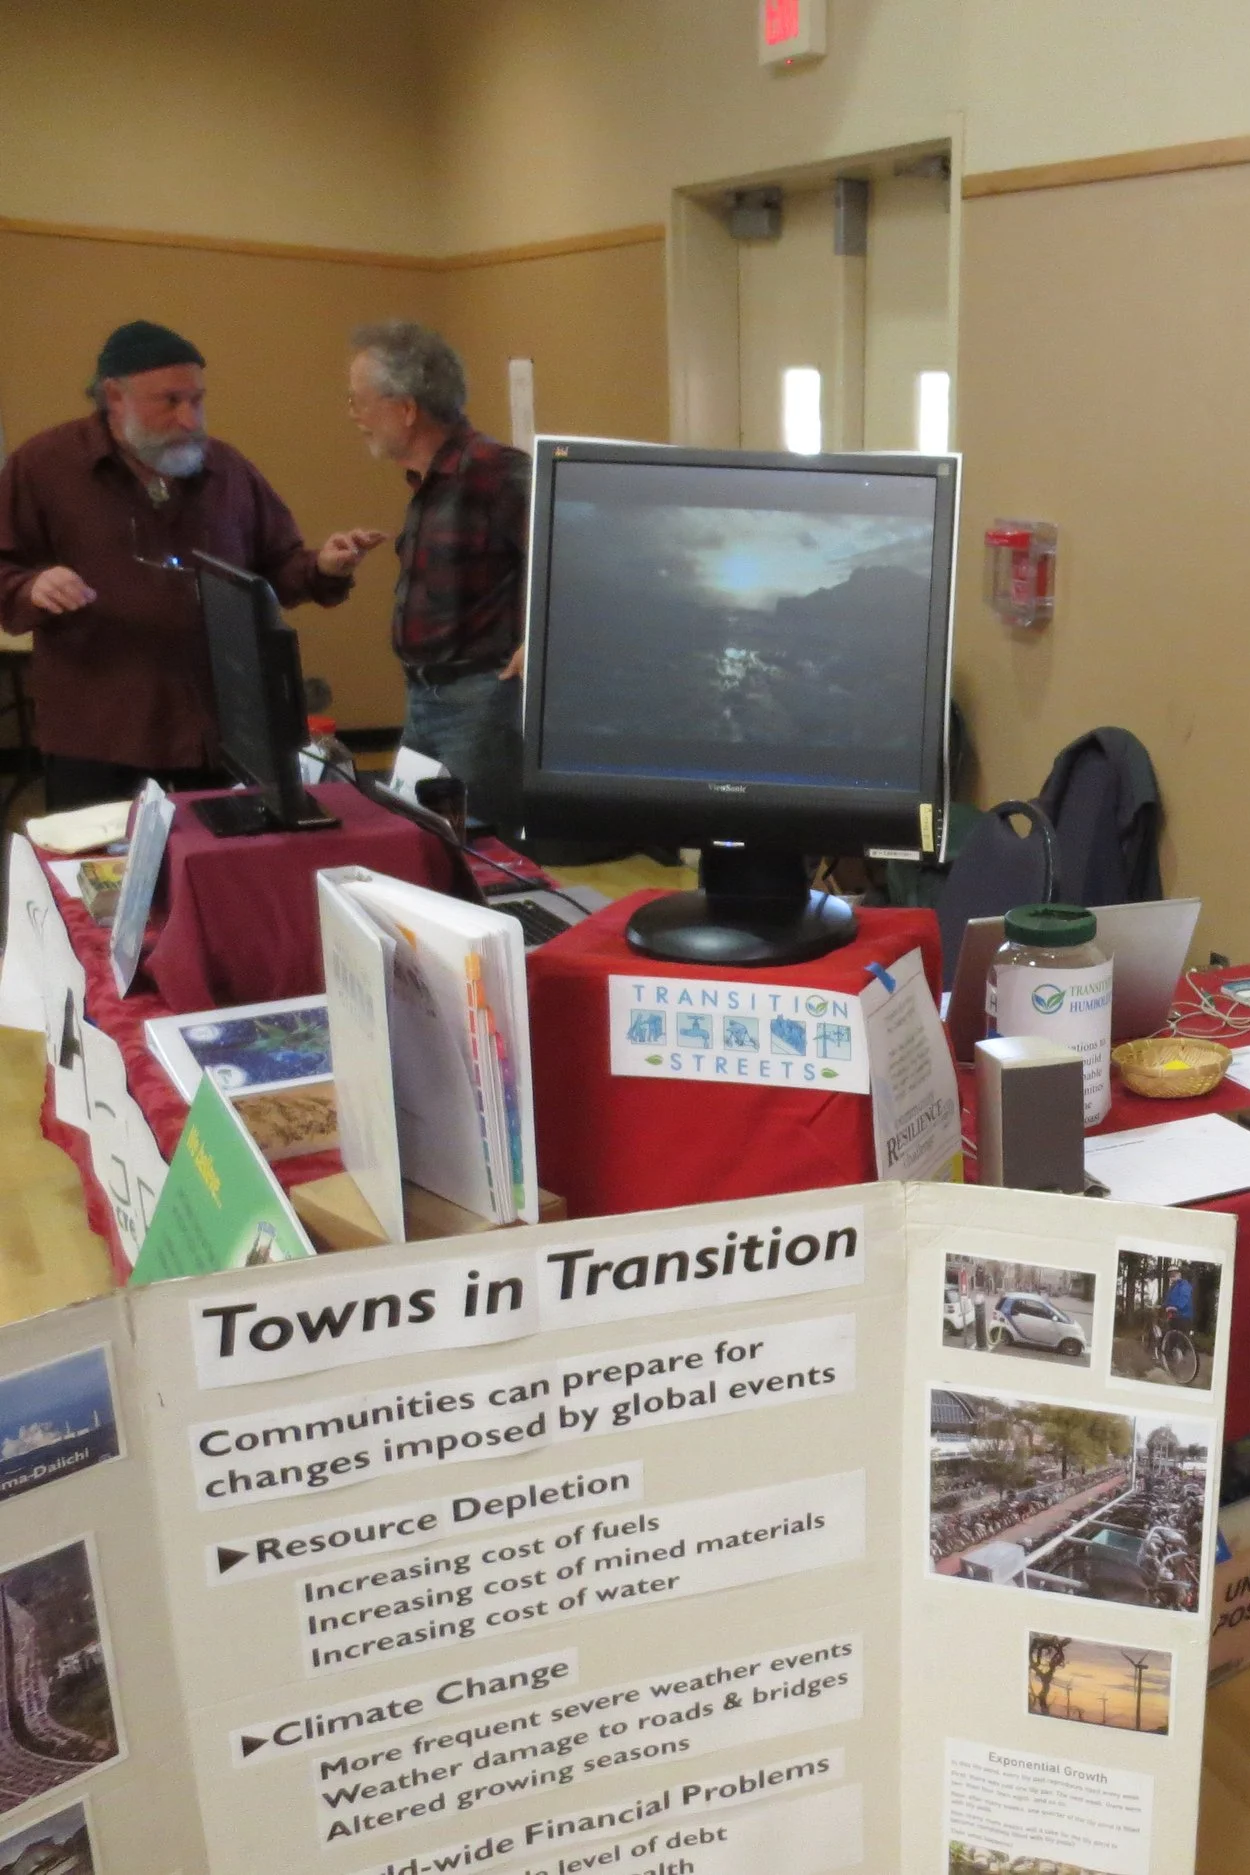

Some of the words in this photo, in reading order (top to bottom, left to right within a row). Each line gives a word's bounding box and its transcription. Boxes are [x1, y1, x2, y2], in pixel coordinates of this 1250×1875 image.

[632, 984, 848, 1019] TRANSITION
[670, 1053, 816, 1081] STREETS
[202, 1288, 436, 1358] Towns
[464, 1269, 524, 1318] in
[546, 1225, 858, 1301] Transition
[199, 1390, 476, 1457] Communities
[488, 1378, 550, 1405] can
[562, 1351, 704, 1397] prepare
[714, 1341, 764, 1365] for
[205, 1450, 371, 1498] changes
[384, 1412, 547, 1462] imposed
[559, 1405, 599, 1432] by
[612, 1381, 717, 1426] global
[728, 1366, 836, 1399] events
[1, 1447, 90, 1491] ma-Daiichi
[255, 1513, 438, 1564] Resource
[452, 1473, 630, 1523] Depletion
[304, 1554, 472, 1603] Increasing
[481, 1538, 545, 1564] cost
[554, 1525, 585, 1550] of
[592, 1514, 660, 1541] fuels
[308, 1585, 474, 1635] Increasing
[484, 1569, 547, 1595] cost
[556, 1556, 587, 1581] of
[594, 1539, 686, 1572] mined
[696, 1512, 826, 1555] materials
[312, 1617, 475, 1668] Increasing
[486, 1600, 549, 1627] cost
[558, 1587, 588, 1611] of
[596, 1574, 681, 1603] water
[272, 1698, 424, 1746] Climate
[435, 1662, 570, 1705] Change
[320, 1747, 402, 1781] More
[413, 1707, 542, 1755] frequent
[551, 1689, 641, 1722] severe
[650, 1661, 762, 1699] weather
[770, 1642, 853, 1672] events
[322, 1761, 463, 1809] Weather
[473, 1731, 589, 1770] damage
[599, 1720, 628, 1740] to
[638, 1701, 713, 1730] roads
[723, 1691, 742, 1711] &
[752, 1670, 849, 1706] bridges
[326, 1792, 447, 1843] Altered
[457, 1764, 574, 1810] growing
[583, 1735, 690, 1773] seasons
[525, 1790, 670, 1845] Financial
[682, 1757, 830, 1806] Problems
[988, 1751, 1061, 1774] Exponential
[1063, 1765, 1109, 1785] Growth
[558, 1845, 621, 1875] level
[631, 1835, 658, 1858] of
[665, 1826, 728, 1851] debt
